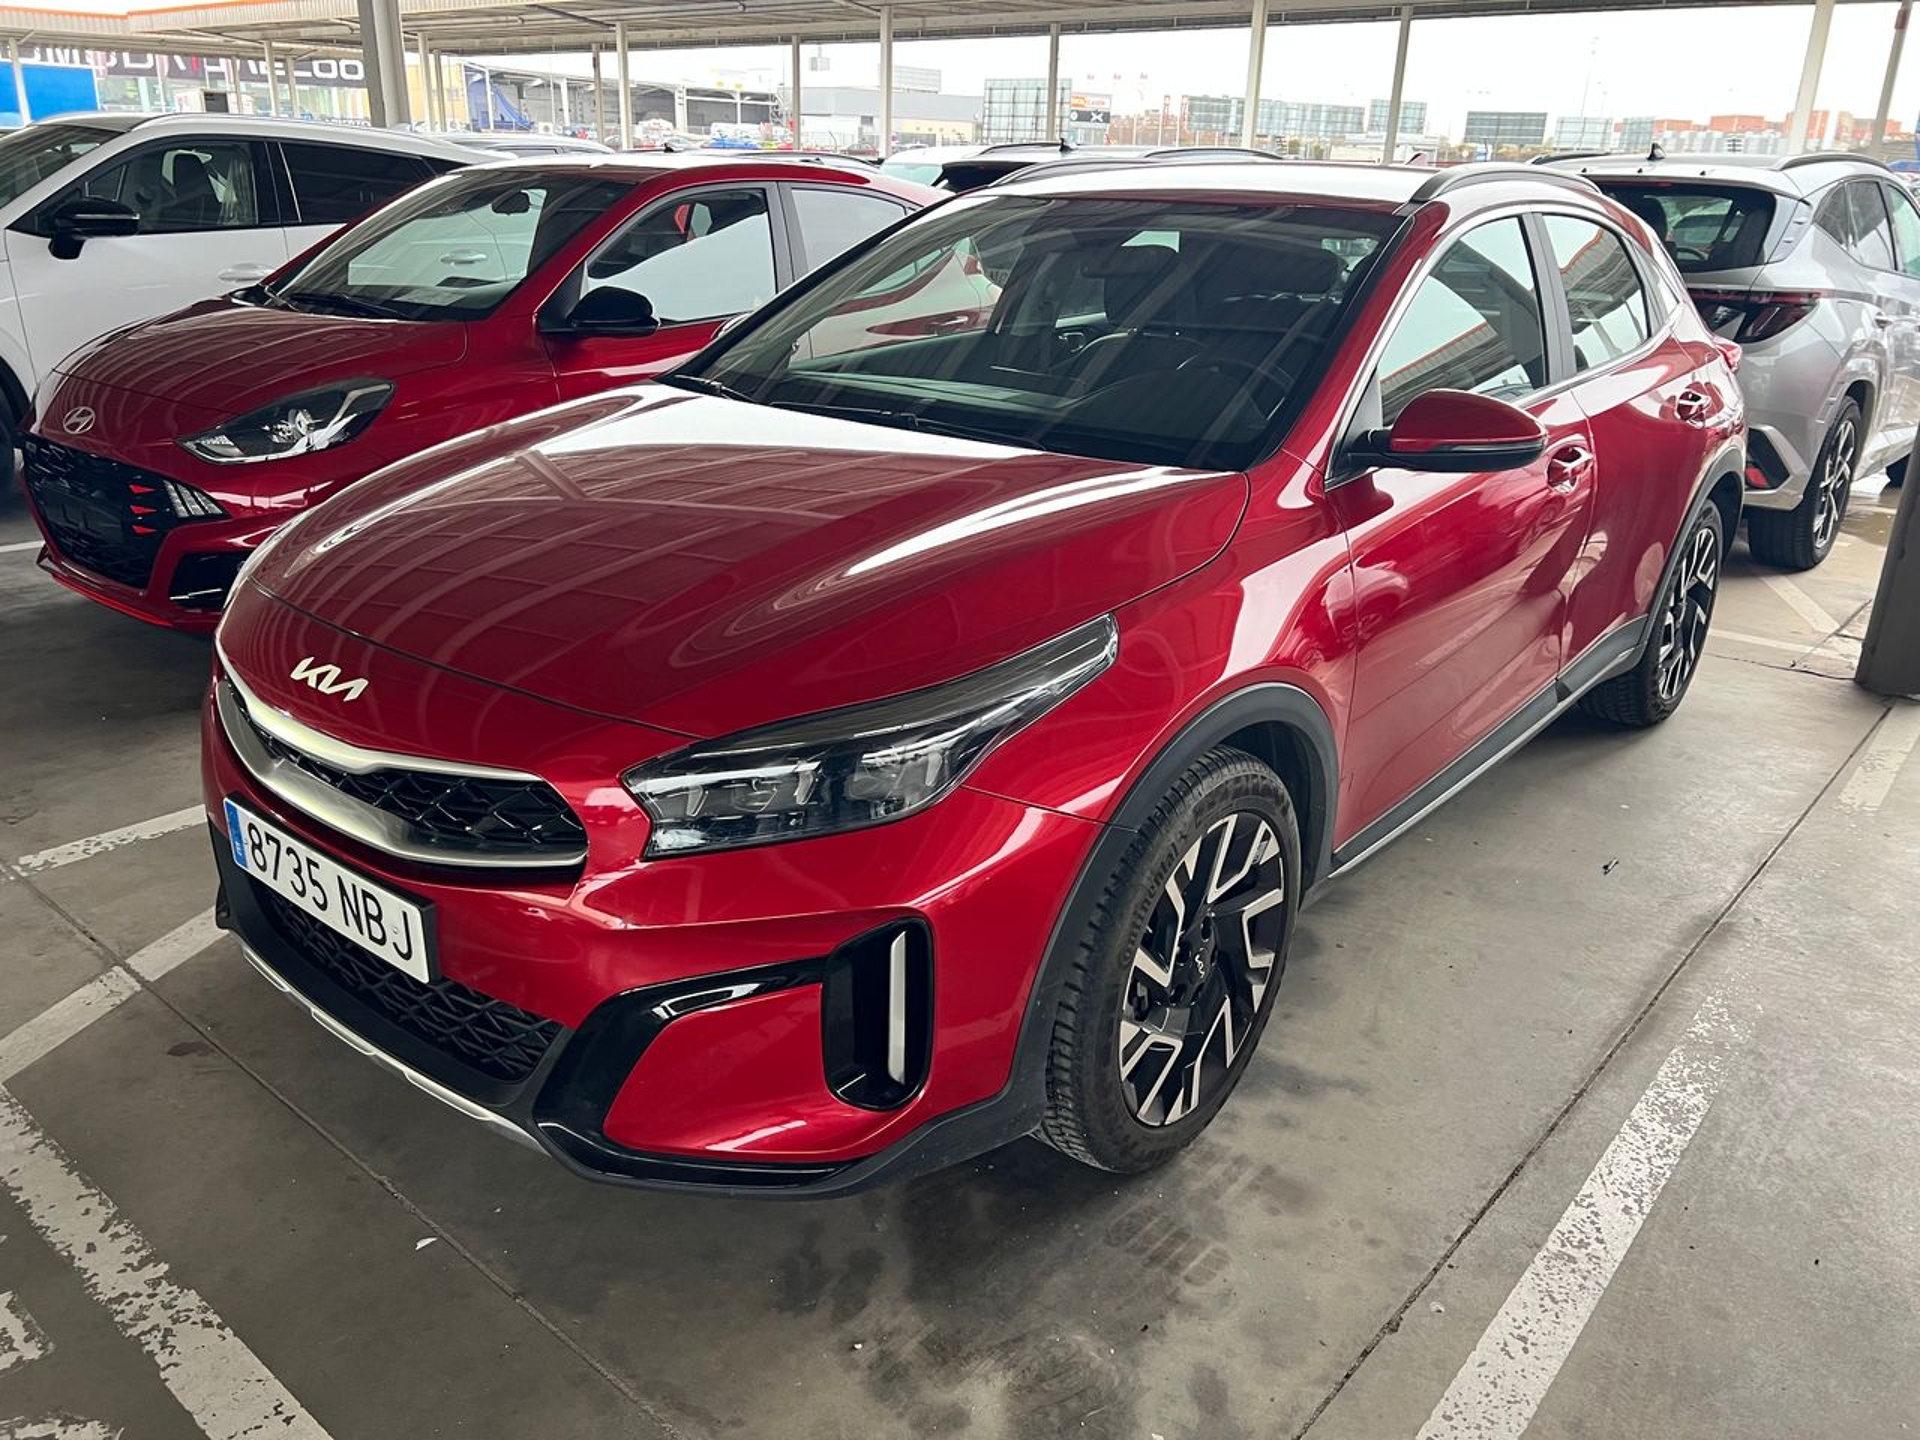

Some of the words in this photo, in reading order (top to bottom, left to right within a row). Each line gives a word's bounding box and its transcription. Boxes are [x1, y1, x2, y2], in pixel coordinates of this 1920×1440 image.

[290, 656, 368, 702] KIA
[248, 822, 329, 912] 8735
[337, 874, 412, 961] NBJ
